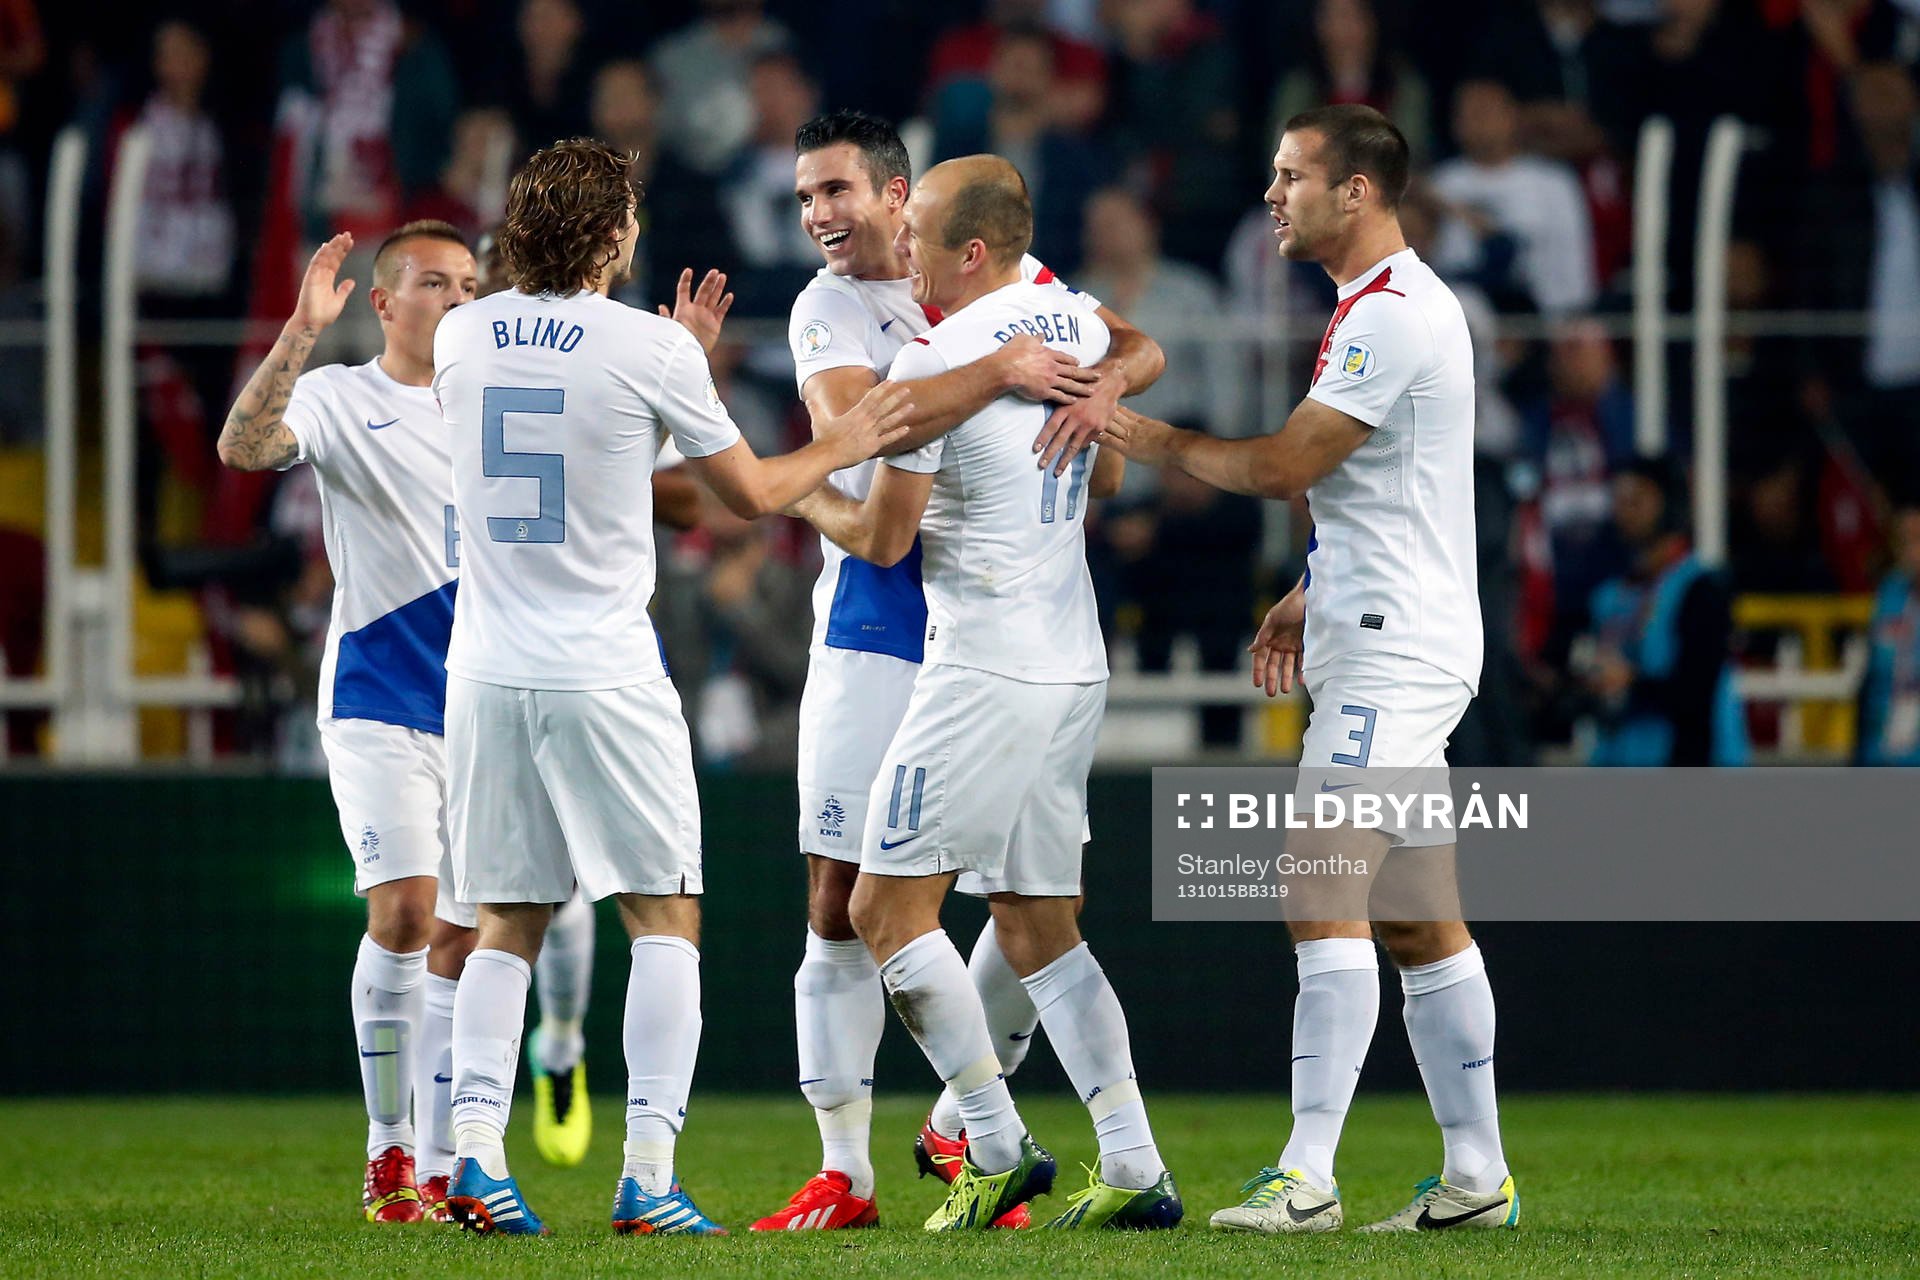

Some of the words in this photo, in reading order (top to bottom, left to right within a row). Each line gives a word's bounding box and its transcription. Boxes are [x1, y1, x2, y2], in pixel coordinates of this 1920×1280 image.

[492, 317, 584, 353] BLIND
[482, 386, 566, 544] 5
[1331, 705, 1378, 769] 3
[888, 764, 927, 831] 11
